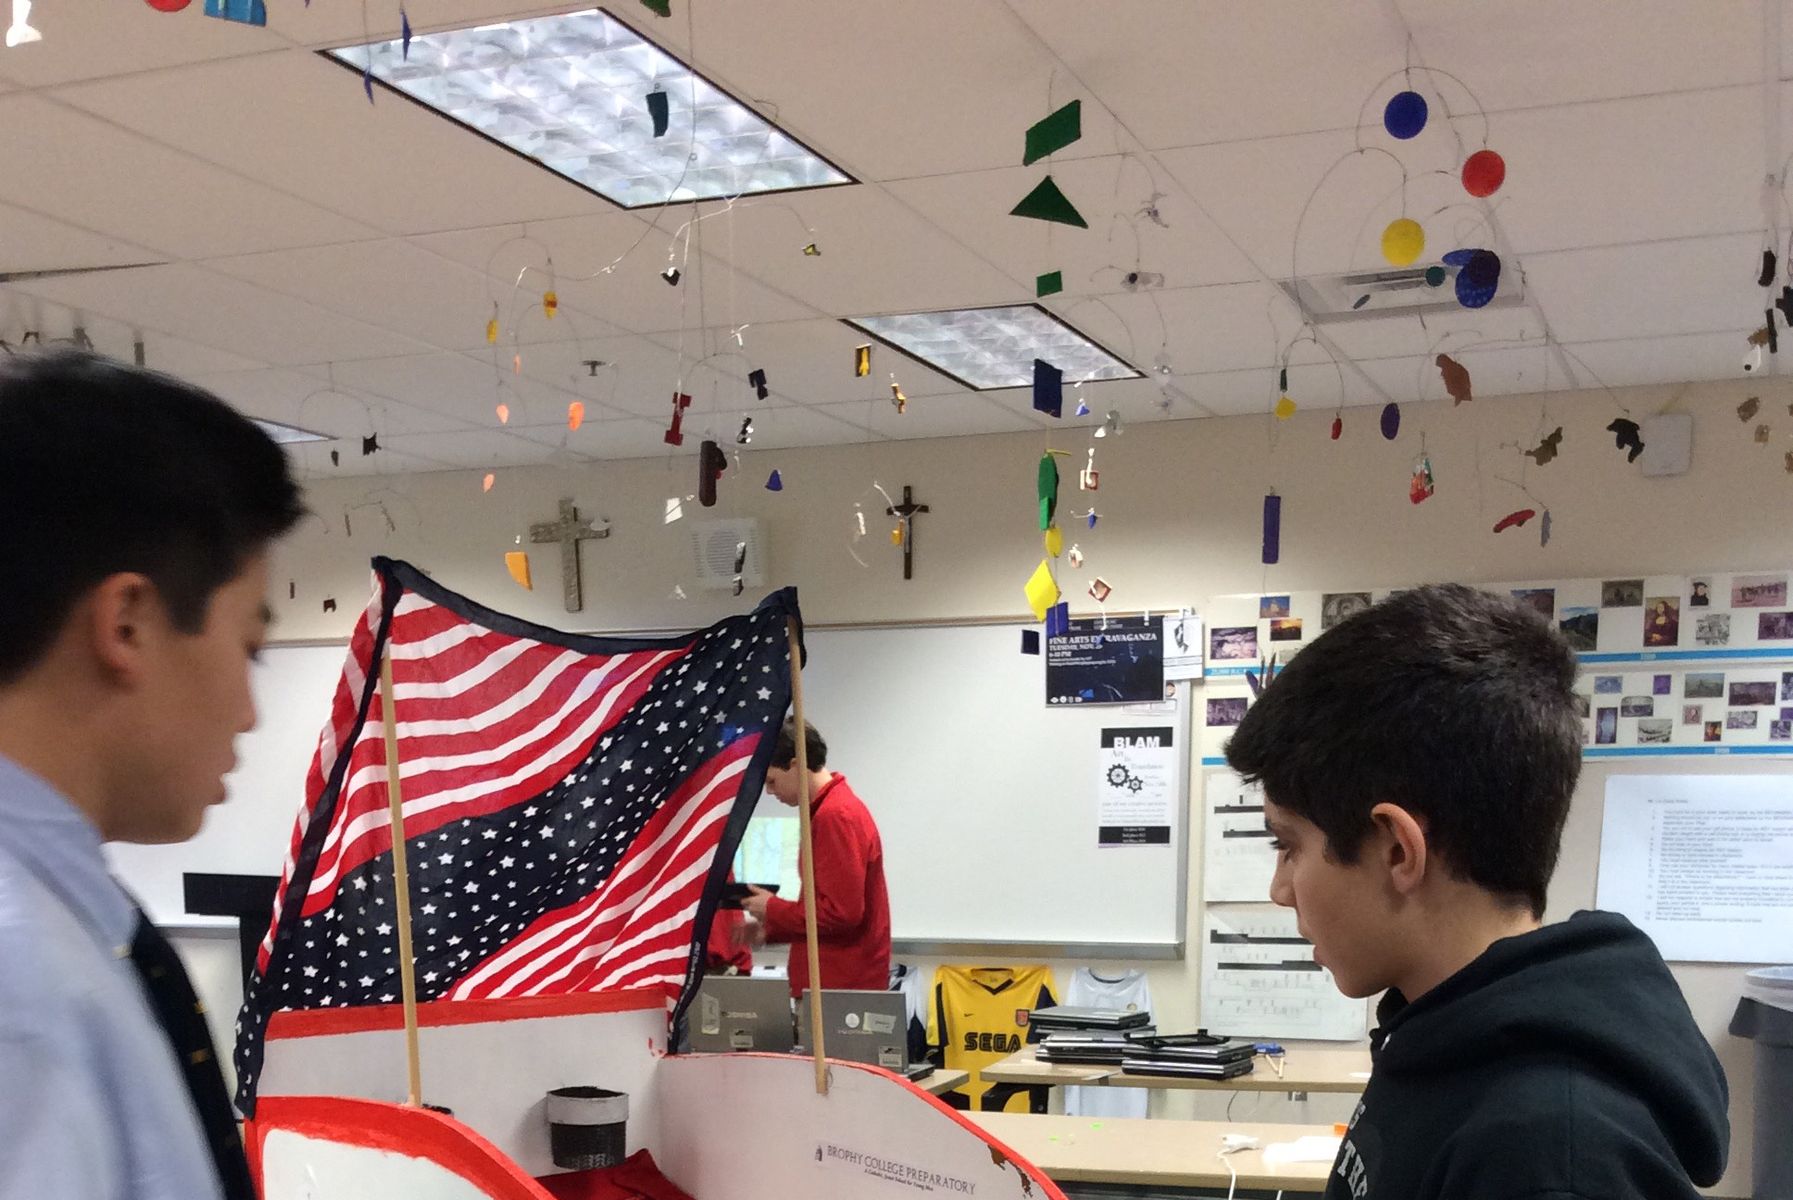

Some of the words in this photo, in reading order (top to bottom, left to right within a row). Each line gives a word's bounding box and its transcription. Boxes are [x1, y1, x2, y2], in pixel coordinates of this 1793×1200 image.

[1069, 636, 1089, 644] ARTS
[1091, 633, 1157, 645] ERAVAGANZA
[1113, 736, 1160, 749] BLAM
[964, 1032, 1022, 1053] SEGA
[827, 1145, 864, 1165] BROPHY
[864, 1155, 904, 1176] COLLEGE
[906, 1166, 976, 1195] PREPARATORY
